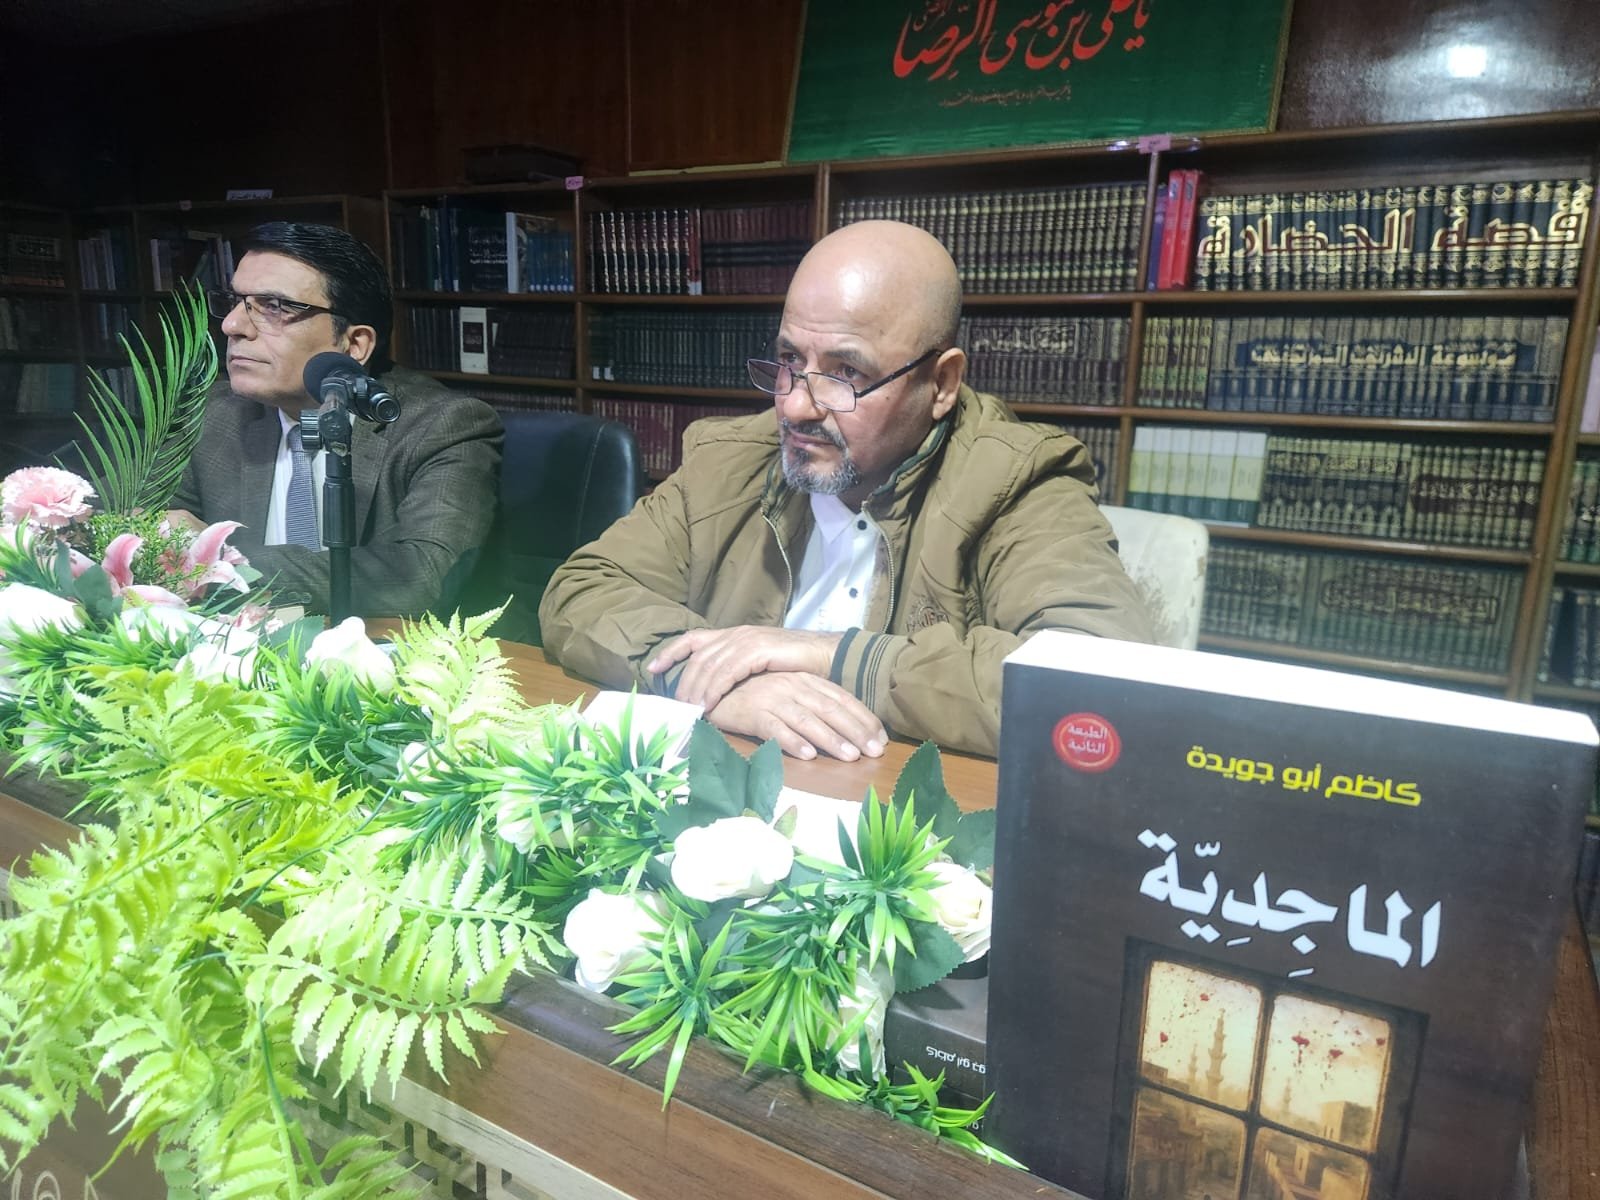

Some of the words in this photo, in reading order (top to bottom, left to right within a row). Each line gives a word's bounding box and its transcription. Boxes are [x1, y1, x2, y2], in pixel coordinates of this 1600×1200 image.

[1197, 208, 1417, 257] الحضارة
[1431, 199, 1590, 252] قصة
[1068, 722, 1108, 739] الطبعة
[1068, 739, 1106, 754] الثانية
[1186, 745, 1275, 785] جويدة
[1282, 763, 1322, 792] أبو
[1325, 774, 1422, 807] كاظم
